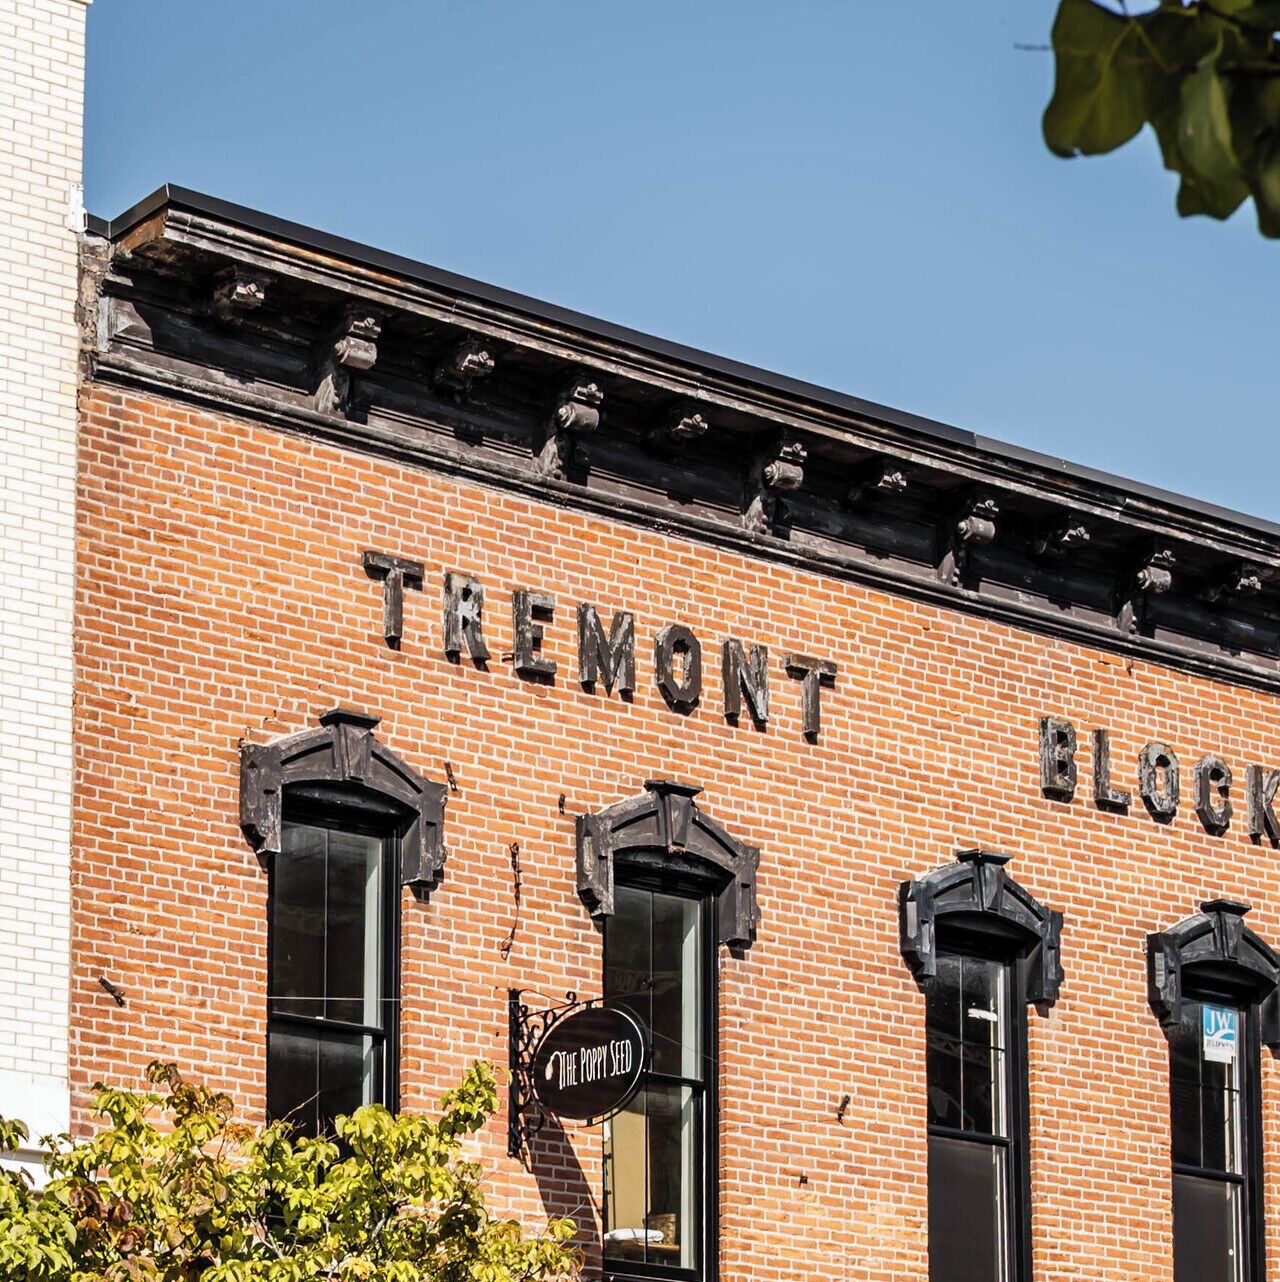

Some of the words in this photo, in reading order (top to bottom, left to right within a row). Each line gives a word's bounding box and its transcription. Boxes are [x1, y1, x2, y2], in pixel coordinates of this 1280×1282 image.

[362, 549, 837, 746] TREMONT
[558, 1049, 578, 1091] THE
[580, 1044, 608, 1084] POPPY
[609, 1039, 633, 1078] SEED
